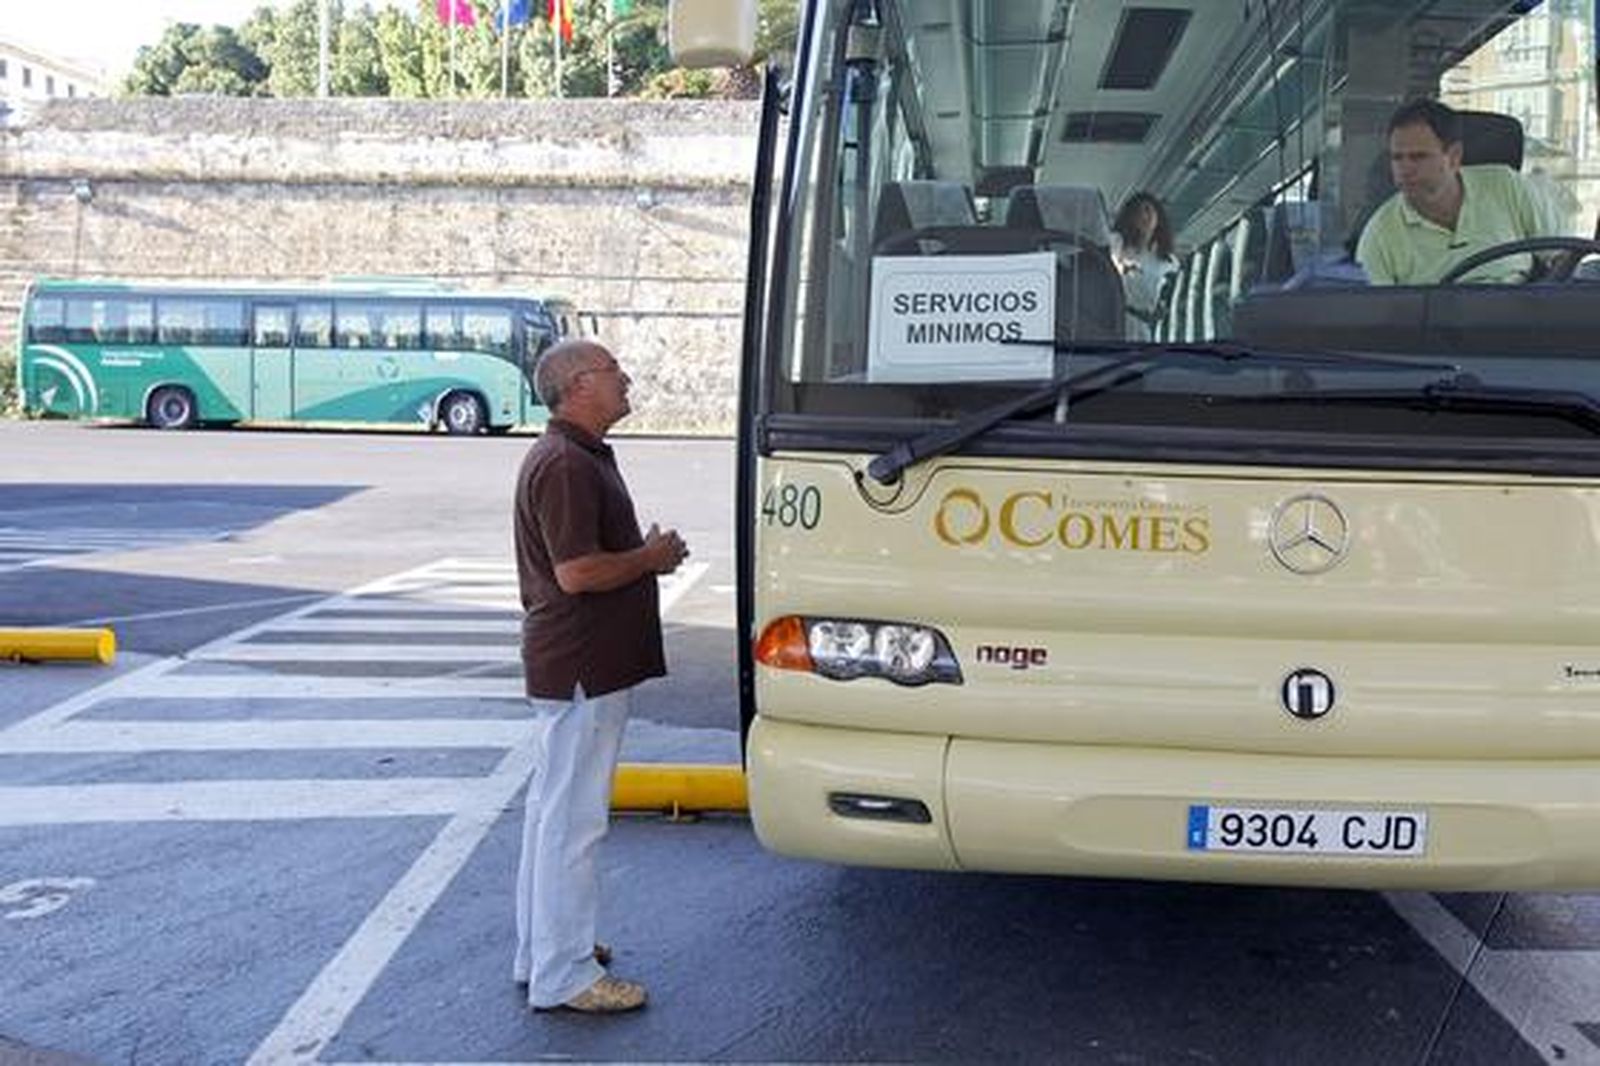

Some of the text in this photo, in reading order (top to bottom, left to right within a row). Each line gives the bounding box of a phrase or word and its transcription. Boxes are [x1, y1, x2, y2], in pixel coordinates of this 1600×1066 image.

[893, 291, 1037, 315] SERVICIOS
[907, 321, 1022, 344] MINIMOS
[762, 484, 821, 530] 480
[976, 645, 1047, 670] noge
[1220, 813, 1417, 850] 9304 CJD
